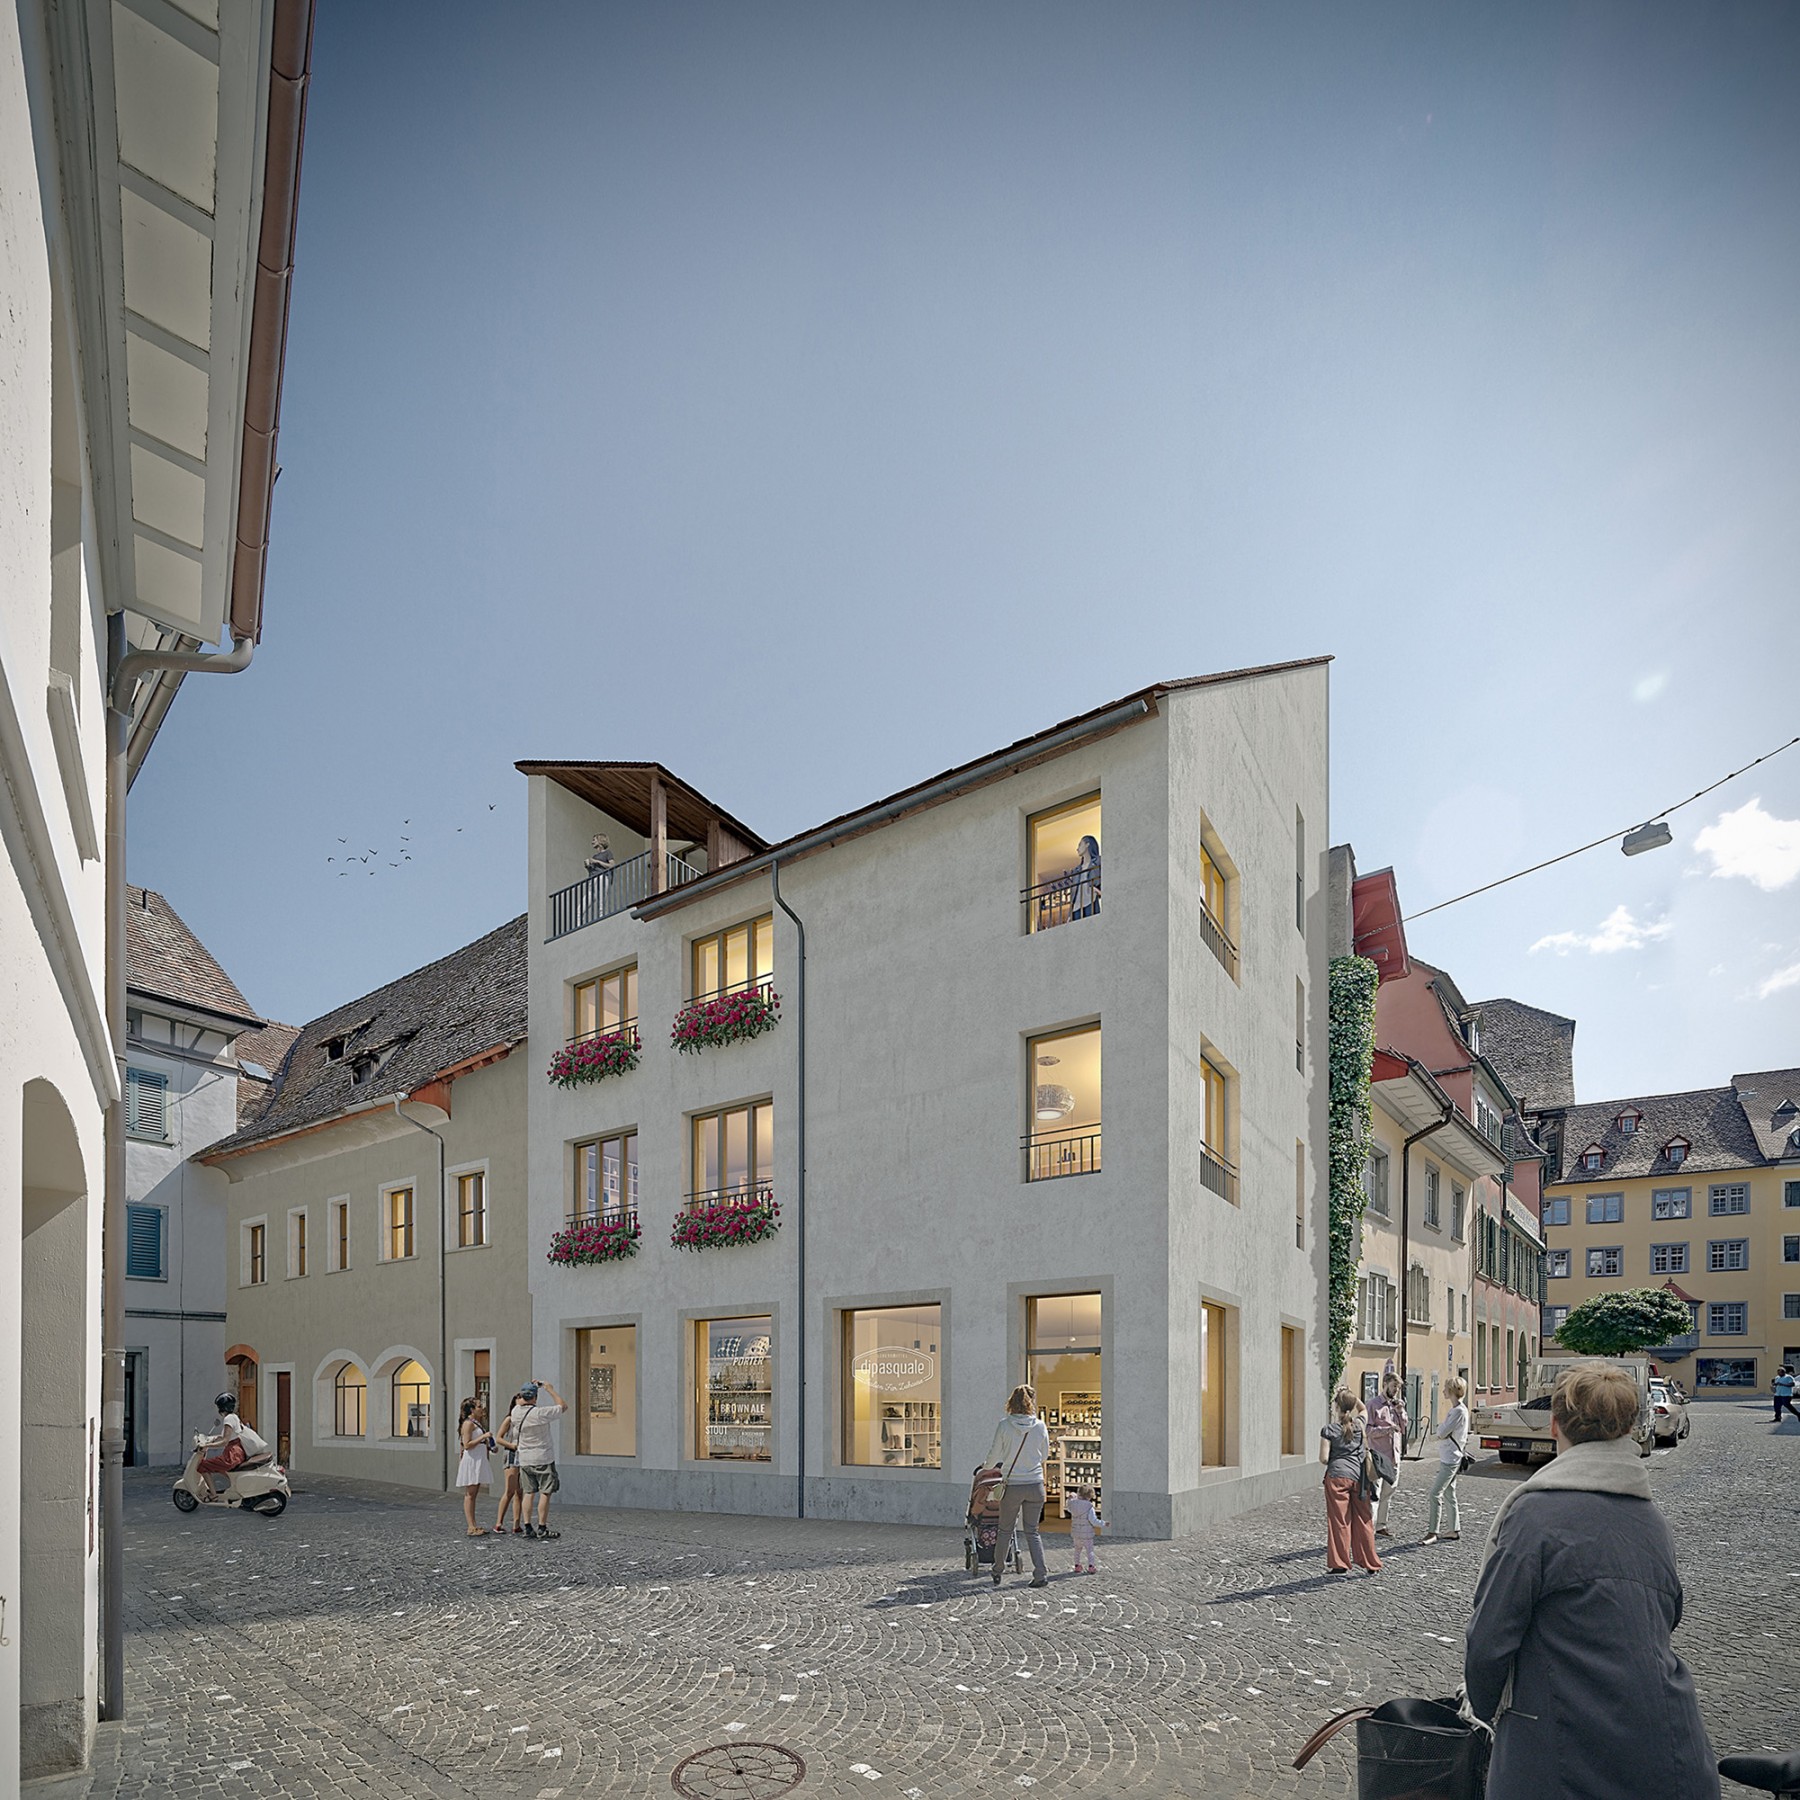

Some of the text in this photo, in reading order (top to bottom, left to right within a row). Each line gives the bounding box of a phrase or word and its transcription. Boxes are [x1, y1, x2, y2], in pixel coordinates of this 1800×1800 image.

[733, 1356, 764, 1366] PORTER
[860, 1359, 924, 1378] dipasquale
[720, 1403, 765, 1413] BROWN ALE
[705, 1425, 728, 1435] STOUT
